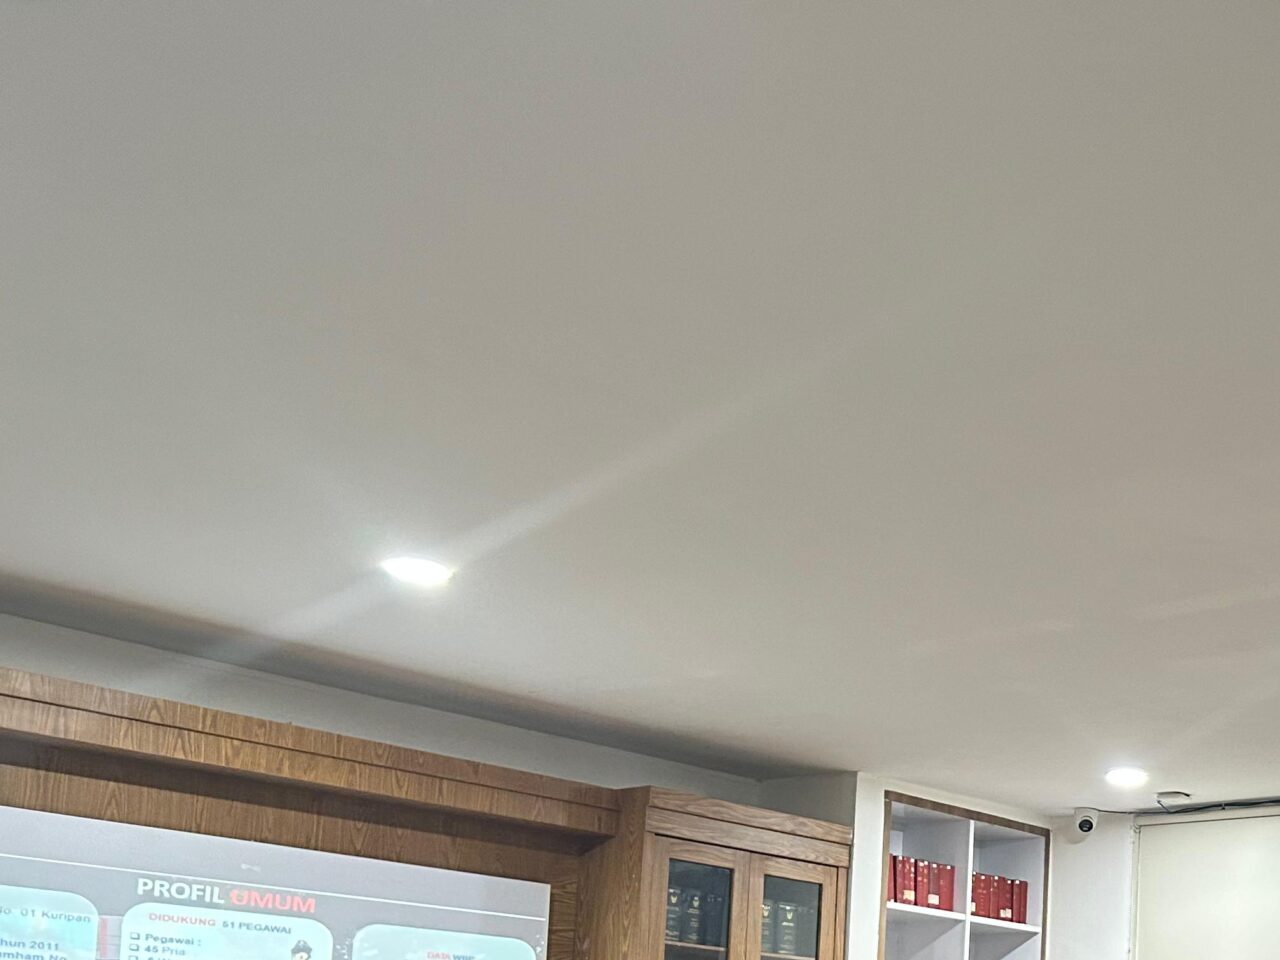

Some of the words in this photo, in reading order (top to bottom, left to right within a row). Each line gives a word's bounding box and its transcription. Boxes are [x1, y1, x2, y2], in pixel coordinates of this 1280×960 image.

[137, 878, 224, 904] PROFIL
[229, 888, 316, 913] UMUM
[148, 912, 216, 927] DIDUKUNG
[238, 921, 292, 934] PEGAWAI
[29, 940, 60, 951] 2011
[144, 933, 195, 946] Pegawai
[144, 945, 159, 954] 45
